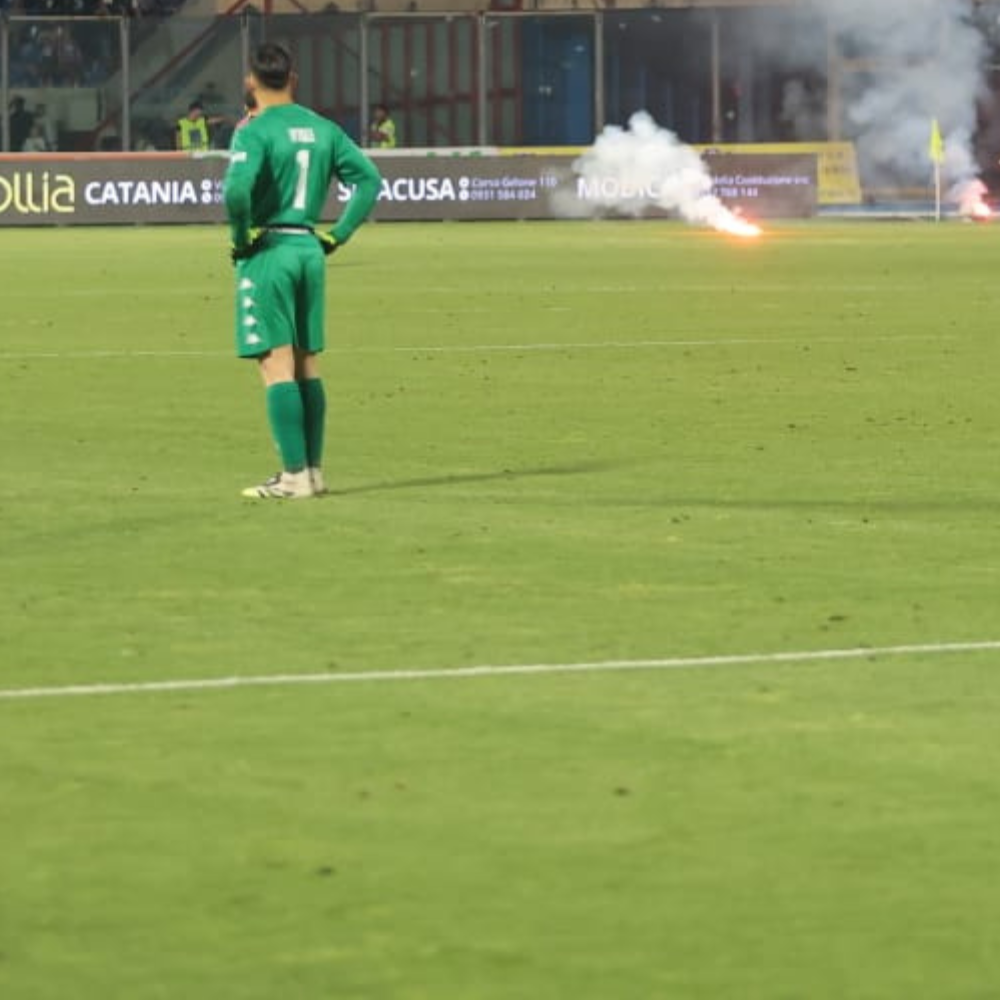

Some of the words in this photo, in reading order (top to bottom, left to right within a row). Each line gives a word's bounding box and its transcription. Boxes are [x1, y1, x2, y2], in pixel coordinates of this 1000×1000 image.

[293, 150, 310, 209] 1
[337, 177, 456, 201] SACUSA
[577, 177, 660, 201] MODIC
[84, 181, 197, 205] CATANIA
